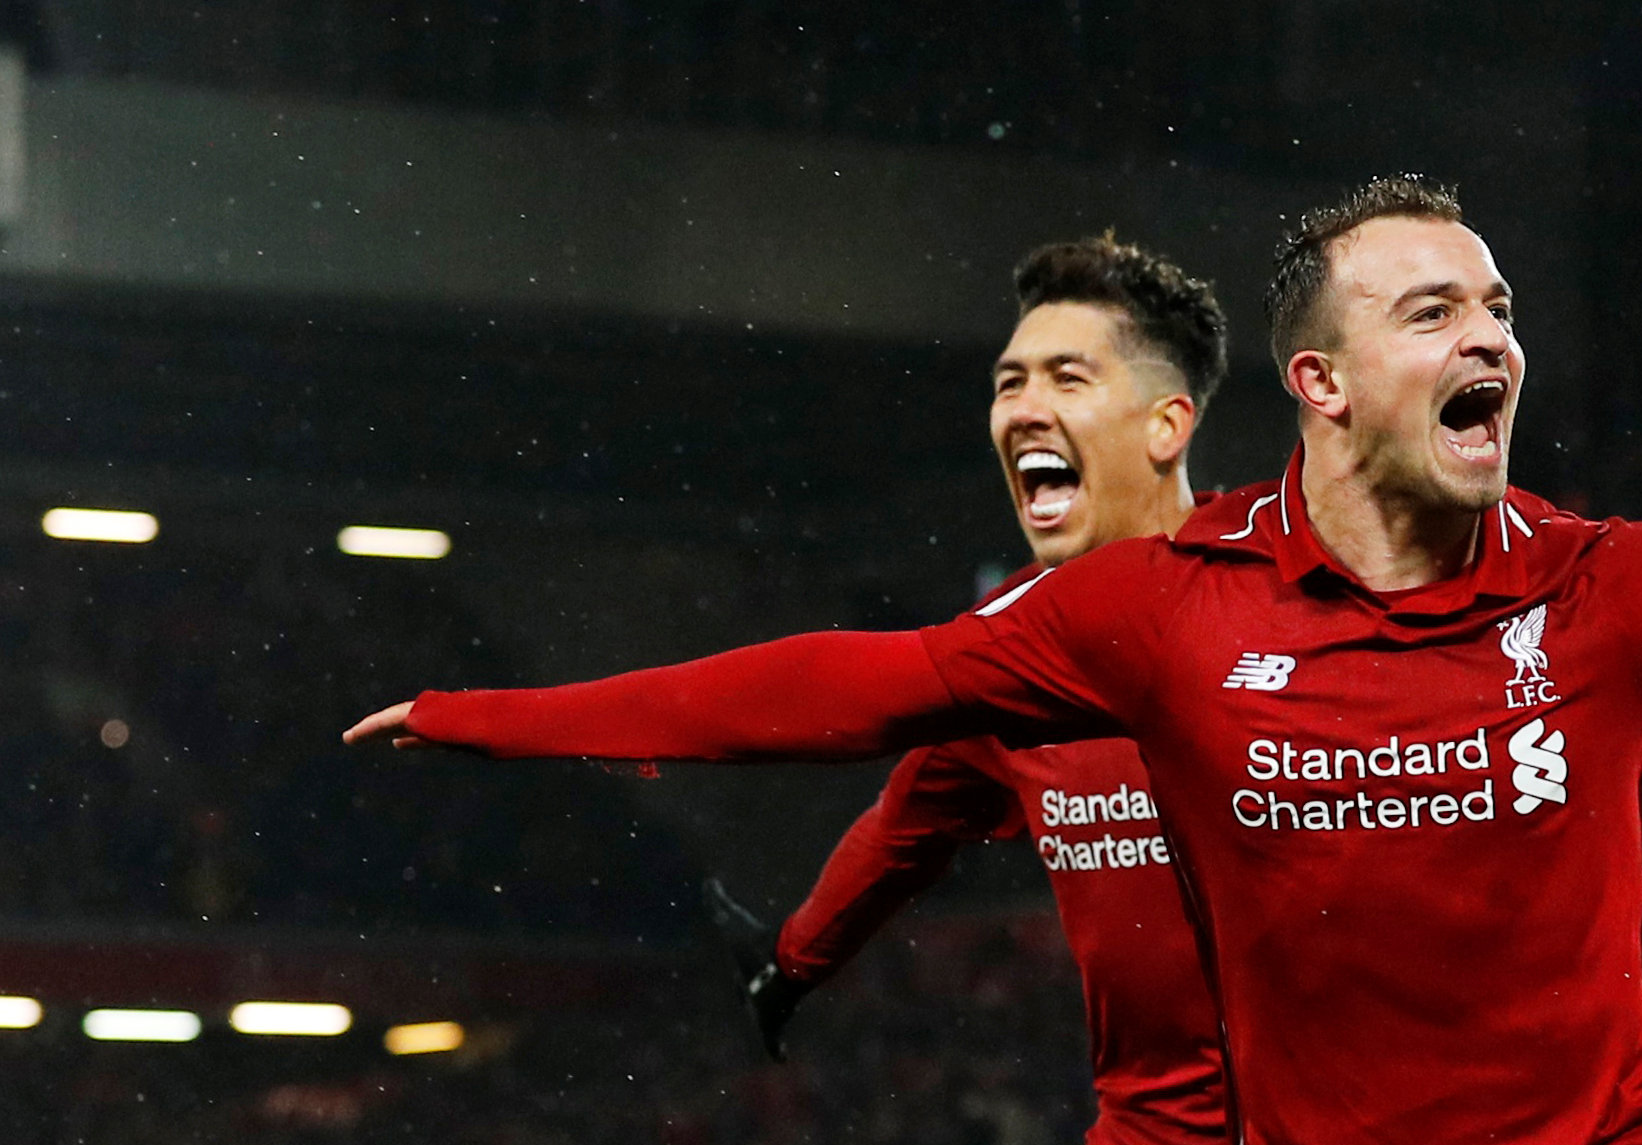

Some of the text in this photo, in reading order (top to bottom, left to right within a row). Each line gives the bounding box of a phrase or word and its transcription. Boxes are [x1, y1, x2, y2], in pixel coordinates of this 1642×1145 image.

[1246, 727, 1490, 781] Standard
[1041, 783, 1158, 827] Standa
[1232, 779, 1495, 831] Chartered
